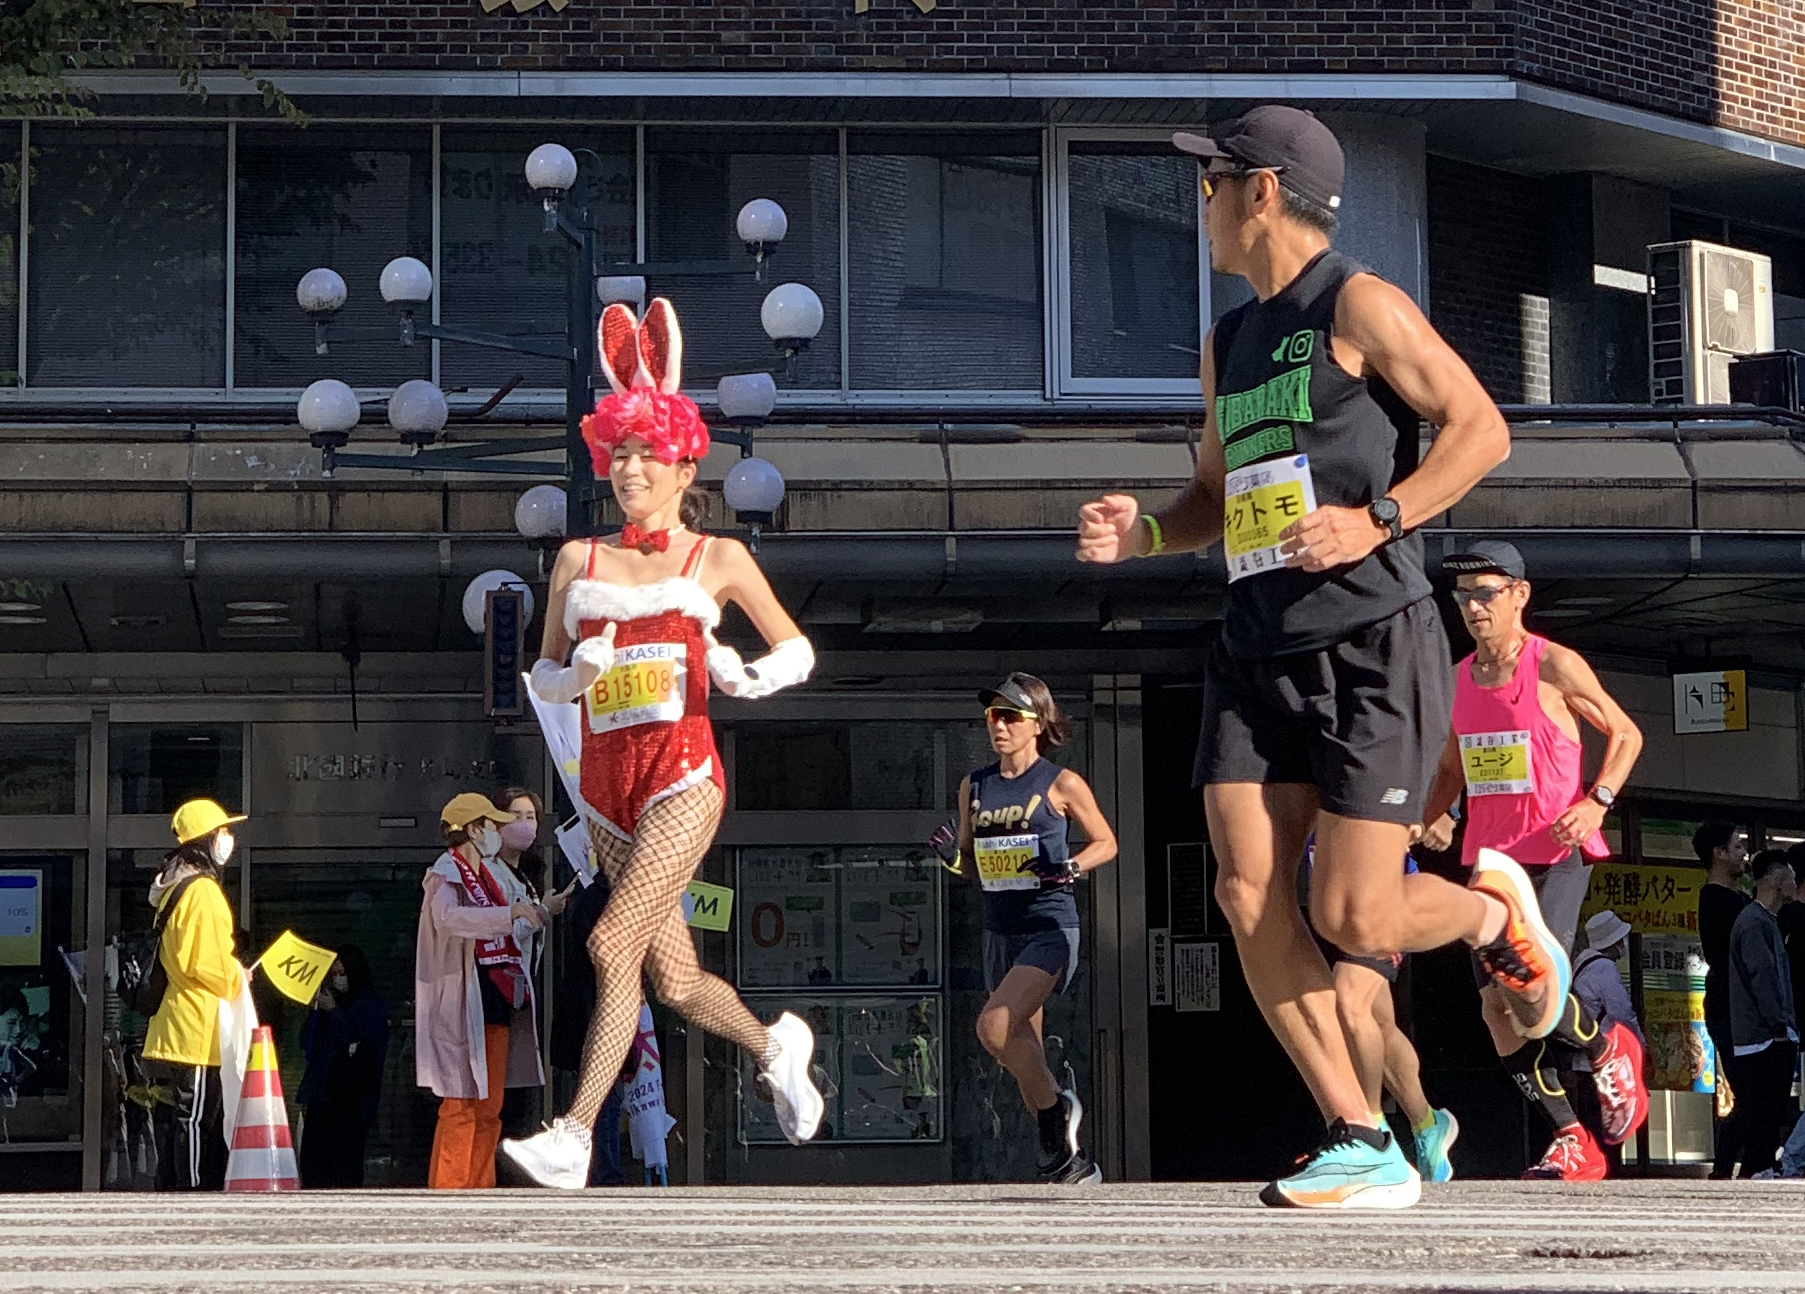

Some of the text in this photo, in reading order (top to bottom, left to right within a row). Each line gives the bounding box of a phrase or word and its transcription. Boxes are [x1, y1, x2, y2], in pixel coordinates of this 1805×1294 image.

[595, 670, 670, 705] B15108
[1471, 752, 1514, 768] ユージ
[690, 893, 718, 916] M
[277, 955, 319, 986] KM
[627, 1081, 655, 1103] 2024
